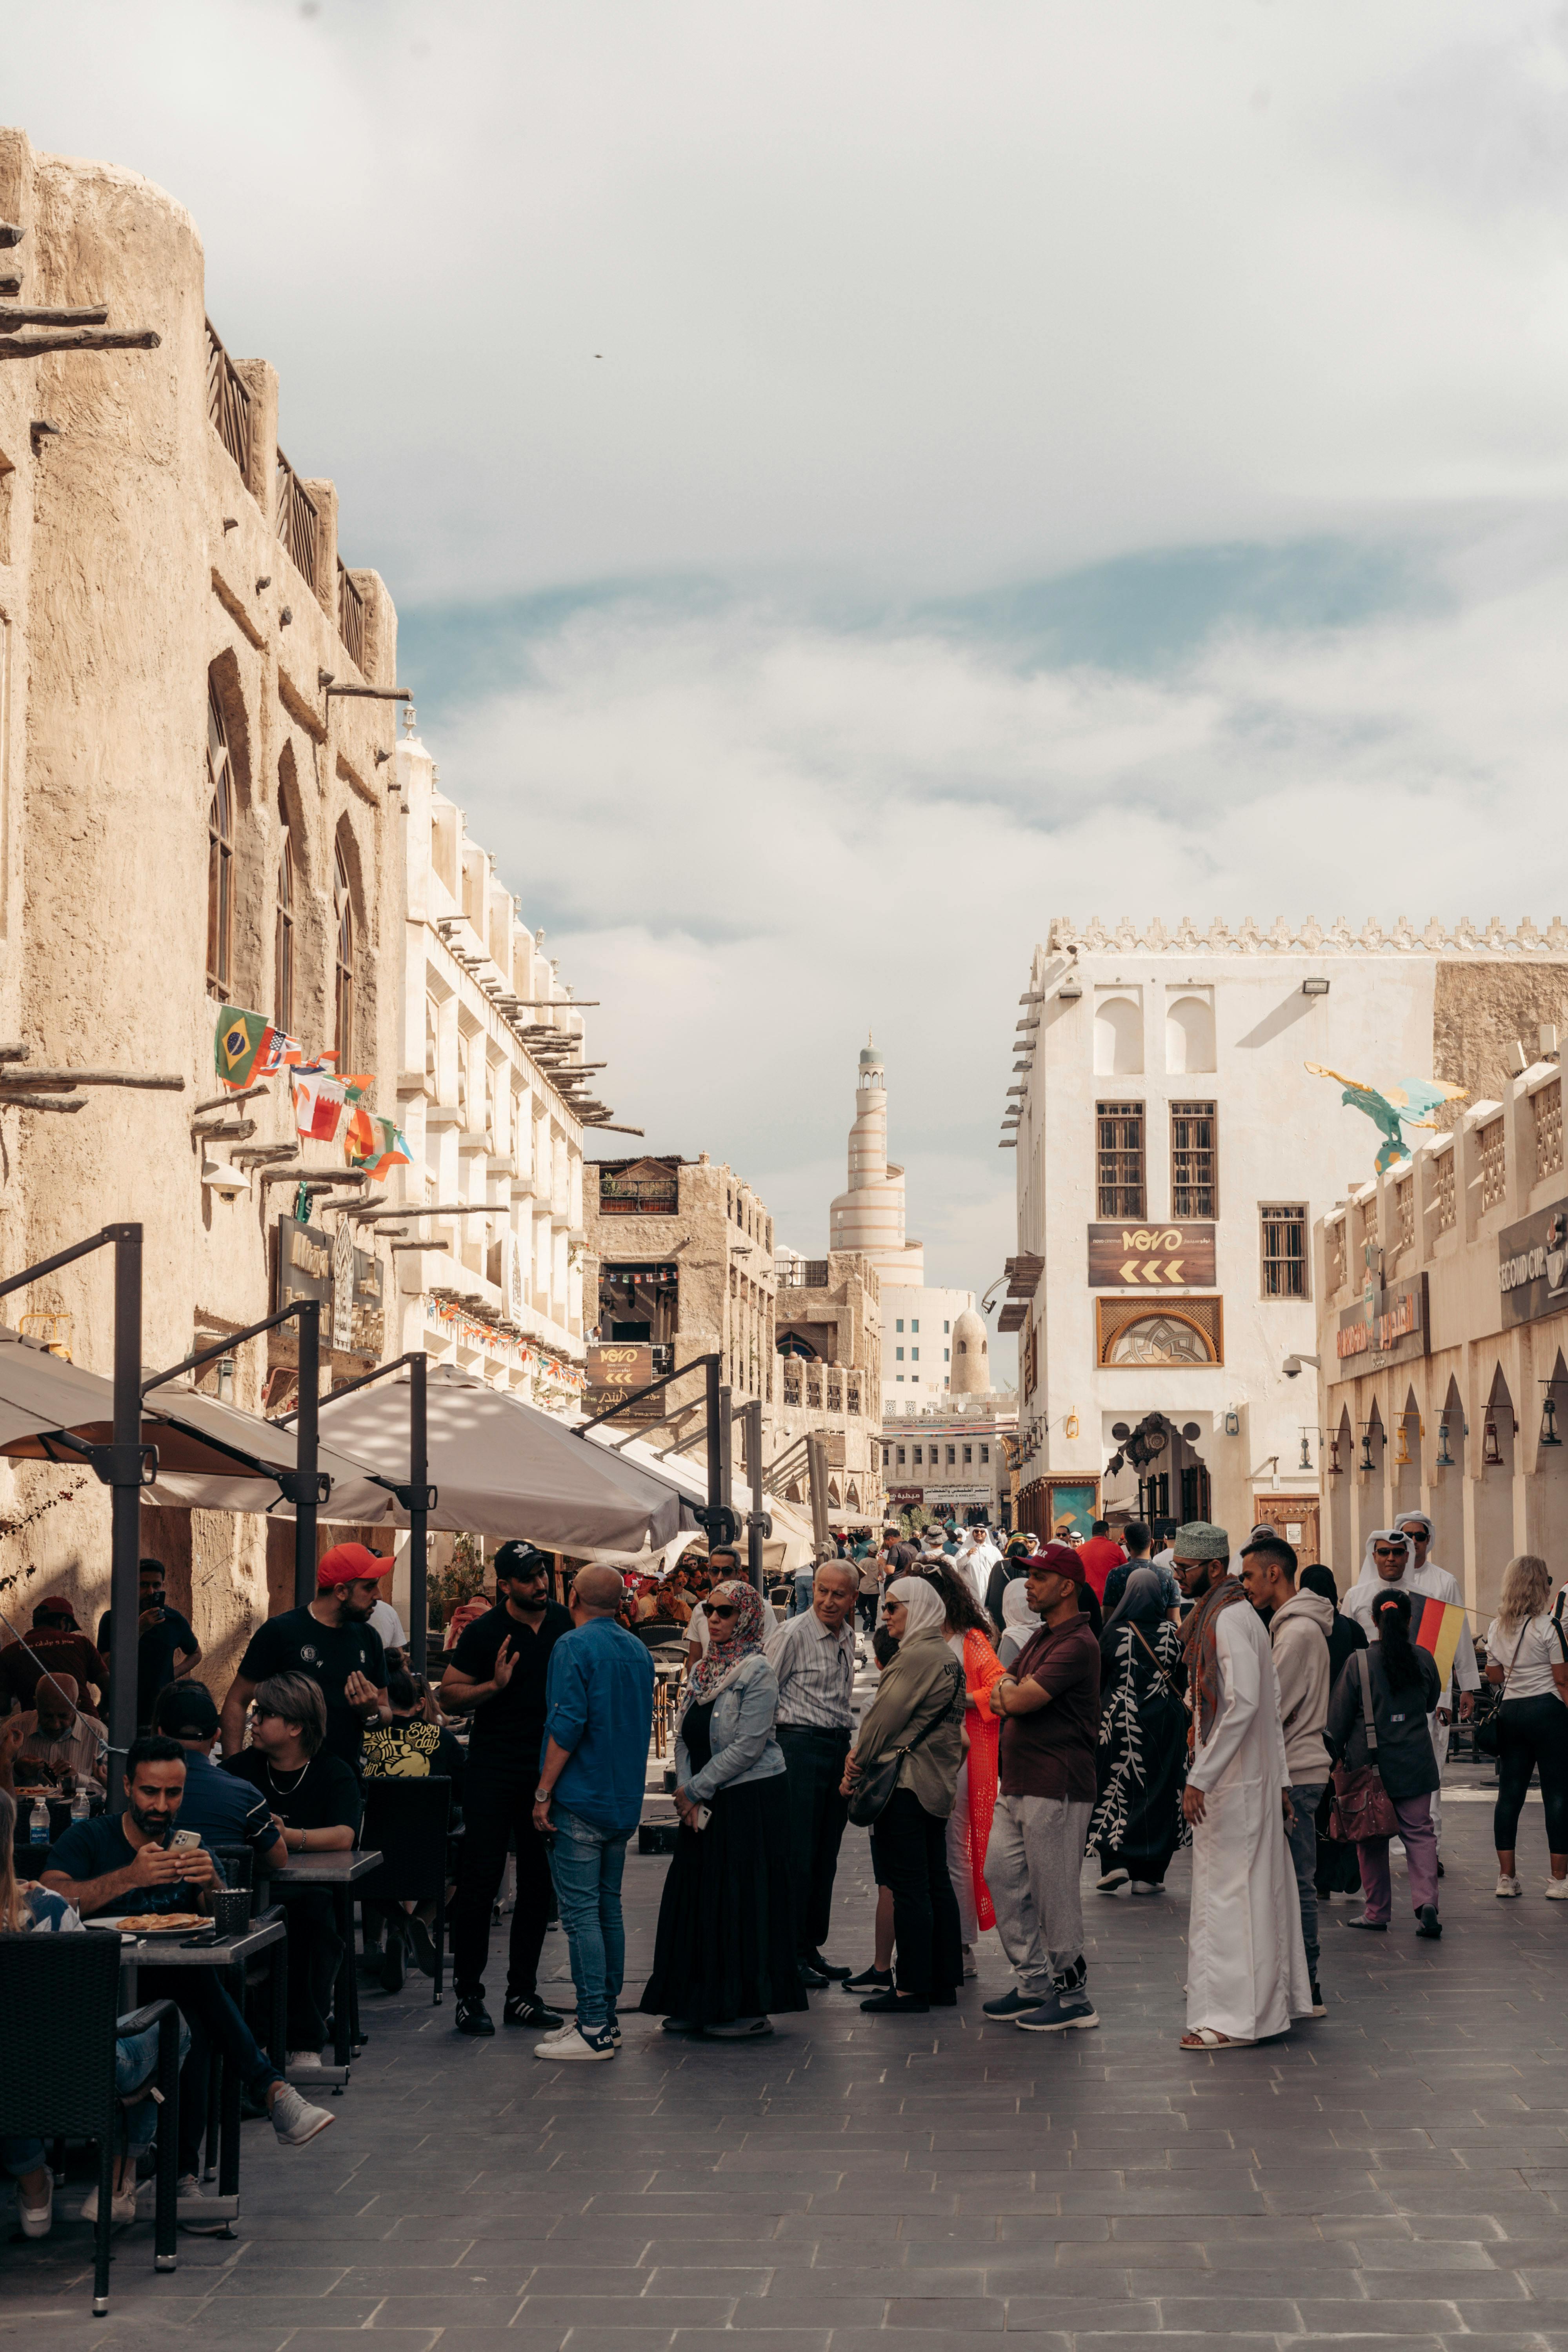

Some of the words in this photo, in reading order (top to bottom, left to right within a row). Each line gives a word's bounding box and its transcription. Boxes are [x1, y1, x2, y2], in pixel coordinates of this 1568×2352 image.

[1498, 1255, 1528, 1292] SECOND
[1529, 1246, 1546, 1280] CUP
[407, 1722, 440, 1739] Every
[415, 1733, 440, 1755] day
